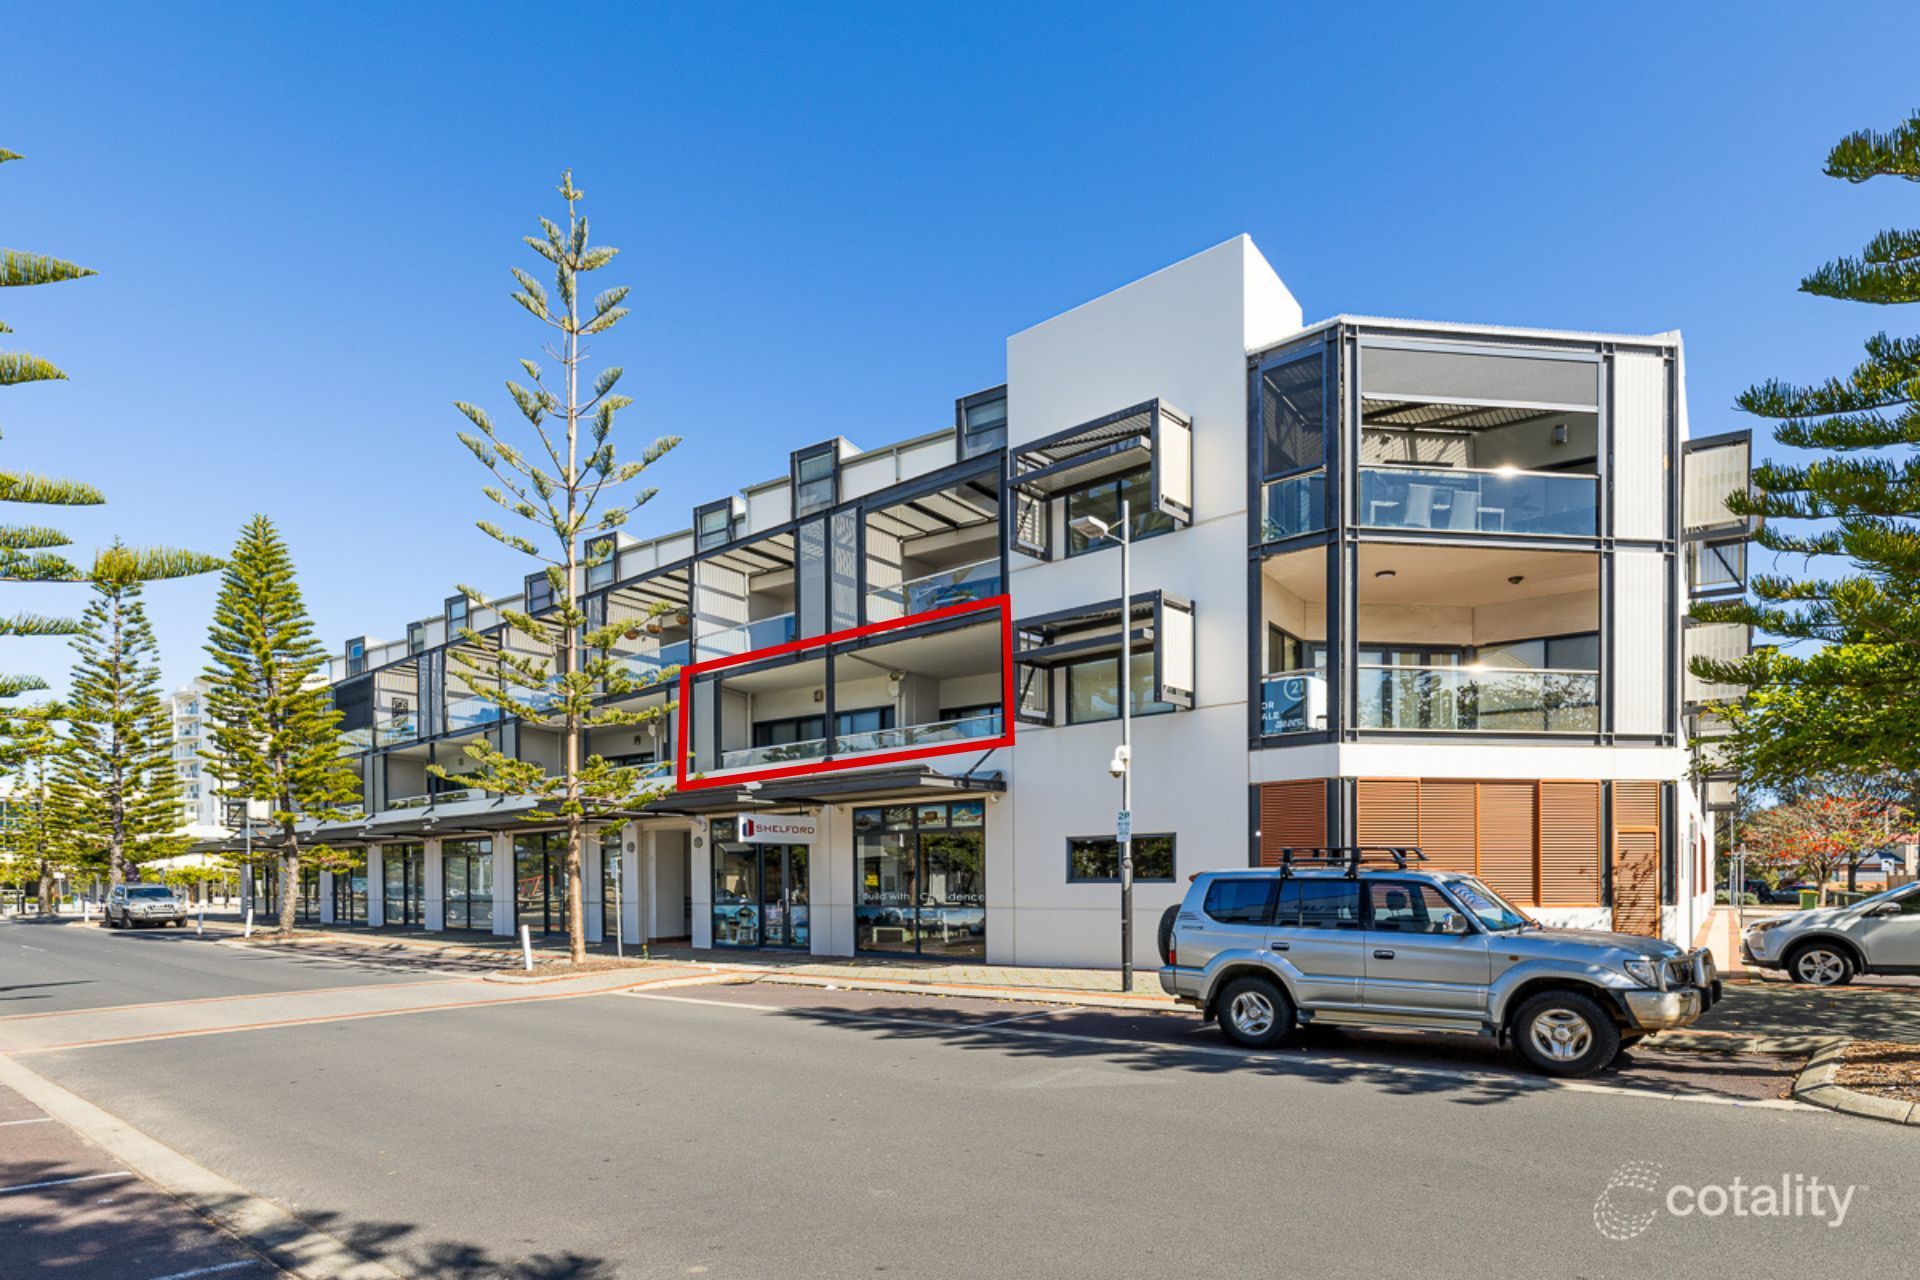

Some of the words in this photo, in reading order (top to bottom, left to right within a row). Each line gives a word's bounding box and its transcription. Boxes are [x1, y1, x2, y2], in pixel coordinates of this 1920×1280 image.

[1261, 701, 1275, 710] OR
[1261, 711, 1281, 721] ALE
[1118, 811, 1130, 820] 2P
[756, 824, 815, 834] SHELFORD
[889, 892, 910, 901] with
[920, 892, 985, 901] Cdence
